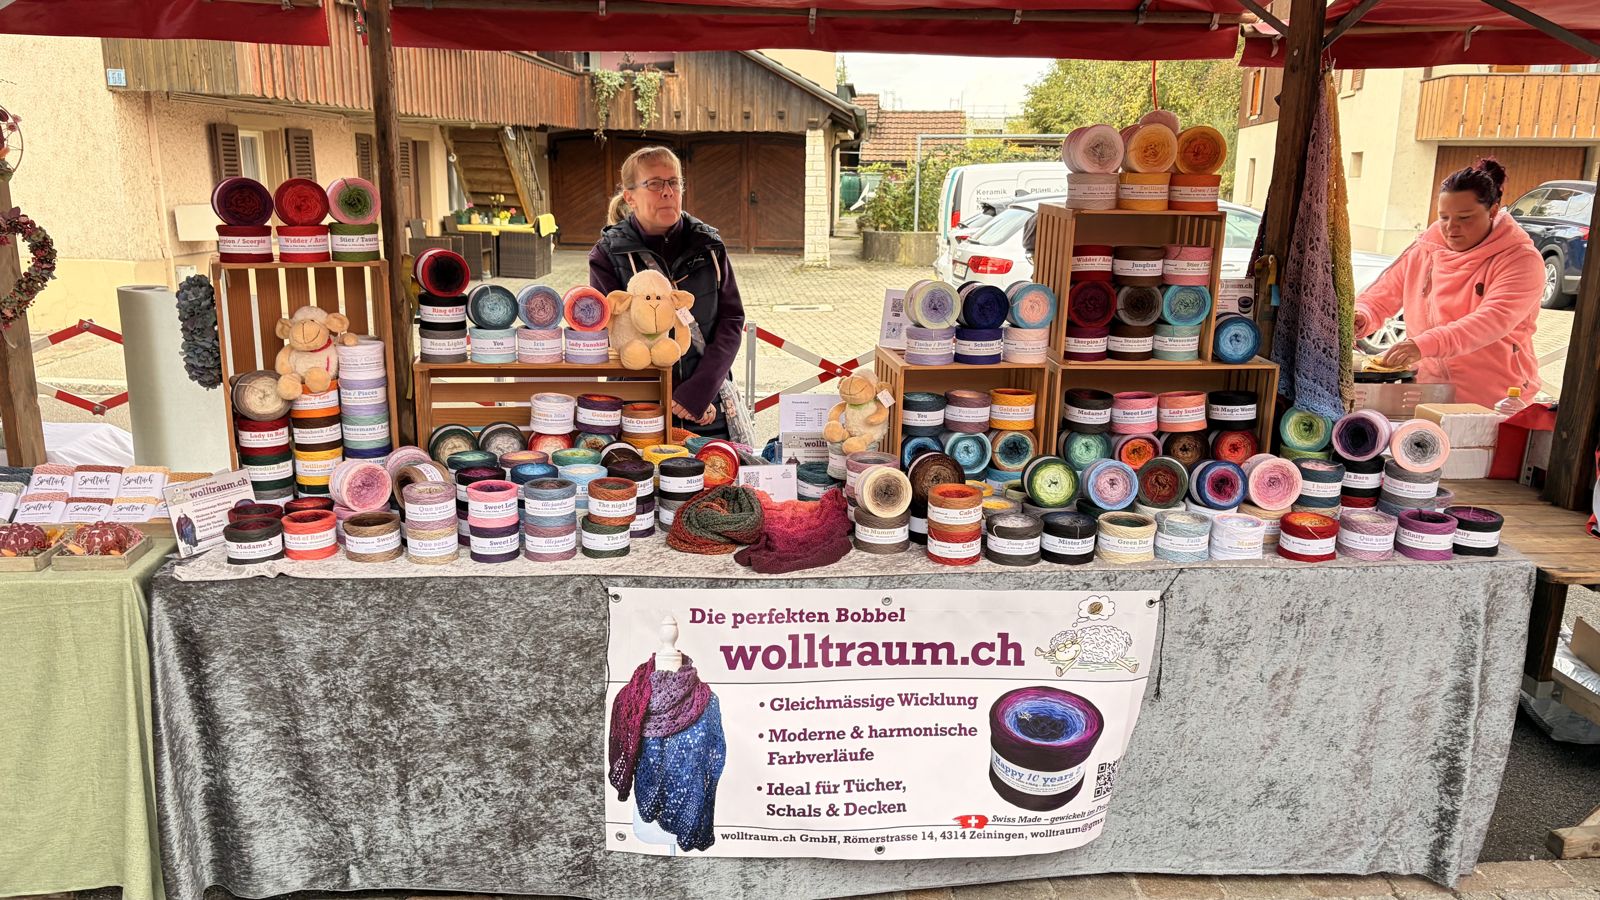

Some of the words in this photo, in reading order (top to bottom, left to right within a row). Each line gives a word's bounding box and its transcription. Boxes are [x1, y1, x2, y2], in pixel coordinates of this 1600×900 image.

[190, 477, 248, 498] wolltraum.ch
[377, 535, 394, 543] Sweet
[689, 608, 726, 624] Die
[732, 608, 829, 628] perfekten
[836, 607, 906, 624] Bobbel
[720, 632, 1026, 672] wolltraum.ch
[770, 695, 894, 711] Gleichmässige
[898, 692, 978, 710] Wicklung
[768, 726, 846, 742] Moderne
[850, 726, 864, 740] &
[868, 723, 978, 740] harmonische
[767, 748, 874, 766] Farbverläufe
[995, 754, 1024, 780] Happy
[1027, 772, 1040, 781] 10
[1042, 772, 1074, 784] years
[766, 780, 811, 796] Ideal
[815, 780, 840, 795] für
[844, 777, 907, 794] Tücher,
[766, 802, 822, 817] Schals
[826, 802, 840, 816] &
[844, 800, 907, 816] Decken
[991, 815, 1016, 823] Swiss
[1018, 815, 1042, 823] Made
[1050, 811, 1086, 825] gewickelt
[1087, 808, 1095, 816] im
[720, 830, 797, 843] wolltraum.ch
[800, 832, 841, 846] GmbH,
[844, 831, 918, 846] Römerstrasse
[920, 830, 938, 842] 14,
[940, 828, 967, 840] 4314
[969, 827, 1028, 841] Zeiningen,
